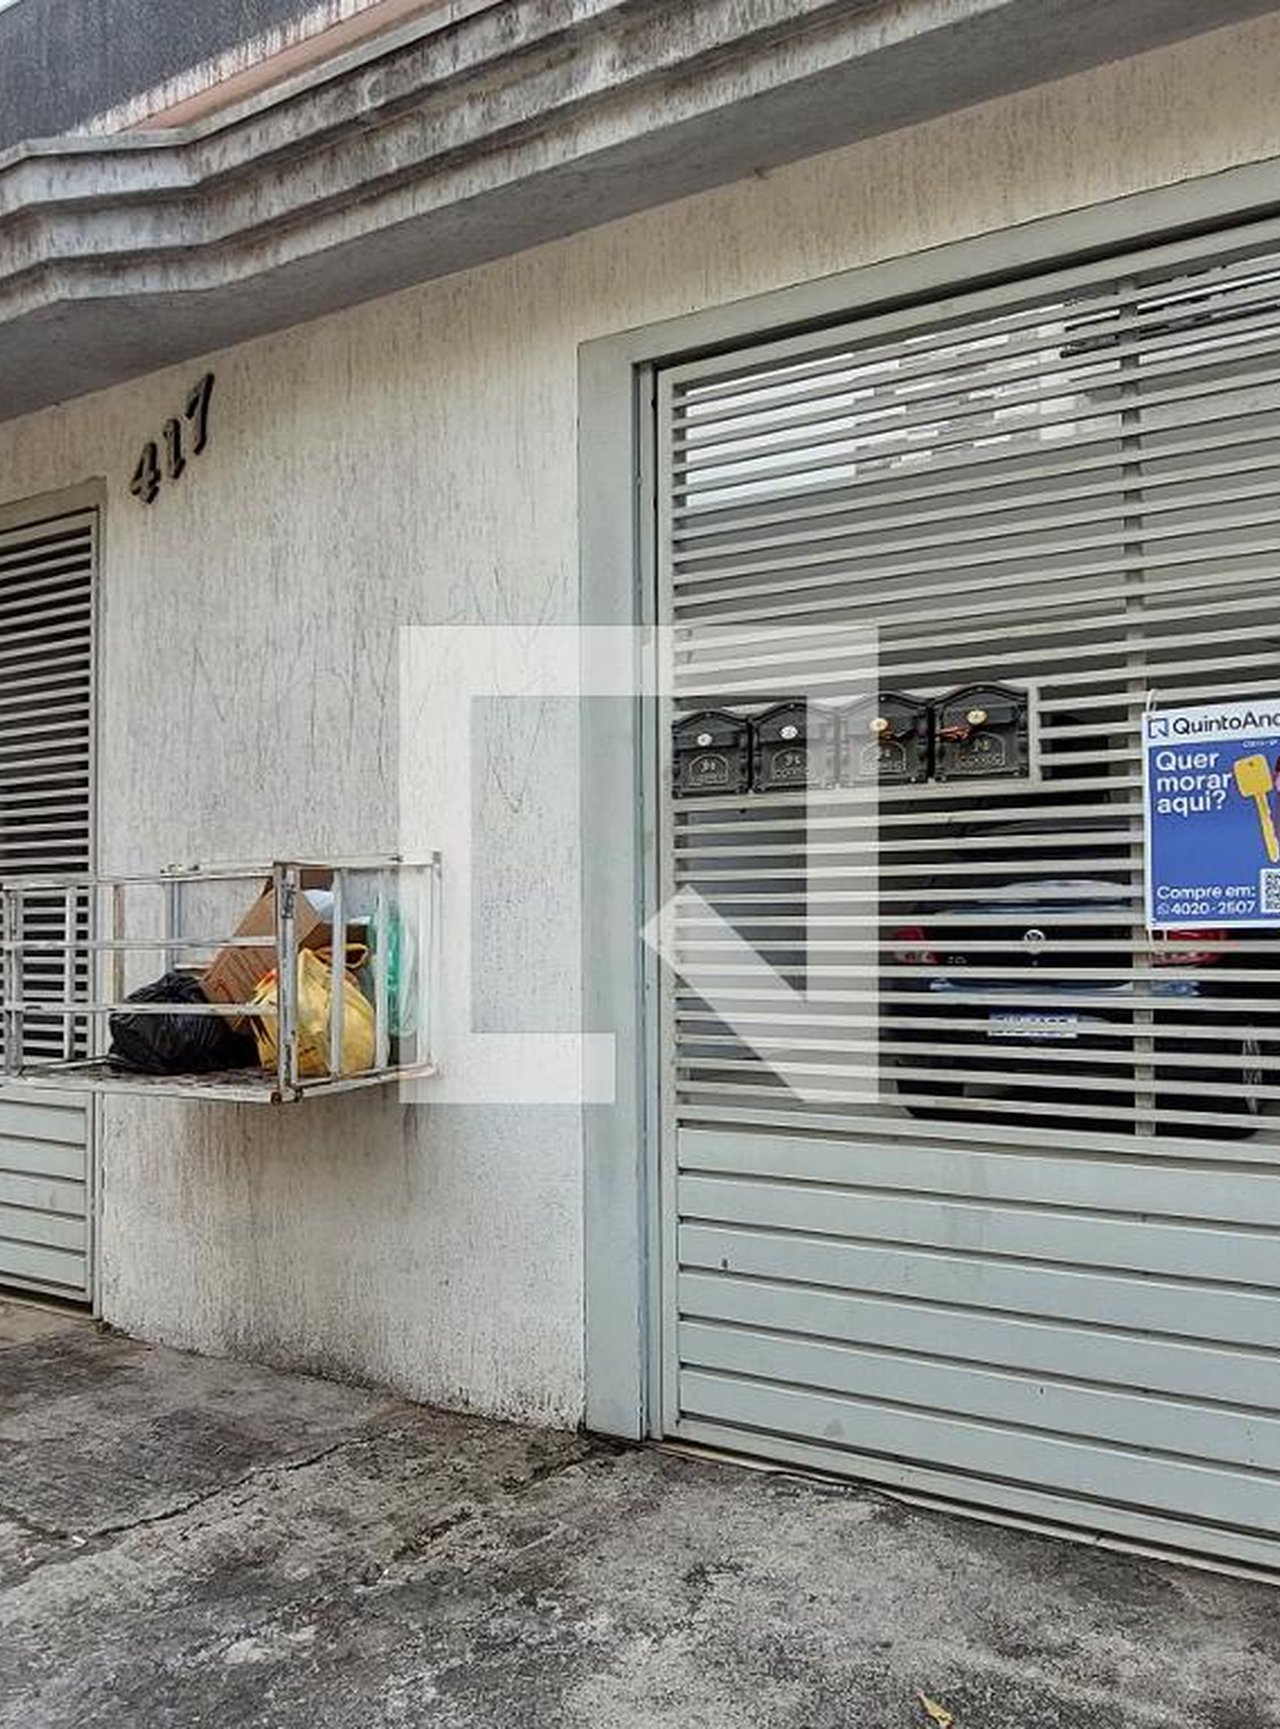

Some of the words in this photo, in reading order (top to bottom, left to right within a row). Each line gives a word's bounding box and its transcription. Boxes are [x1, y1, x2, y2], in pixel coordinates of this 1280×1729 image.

[131, 373, 215, 504] 417
[1156, 751, 1220, 772] Quer
[1157, 772, 1232, 793] morar
[1157, 790, 1226, 817] aqui?
[1157, 885, 1222, 900] Compre
[1225, 886, 1256, 899] em:
